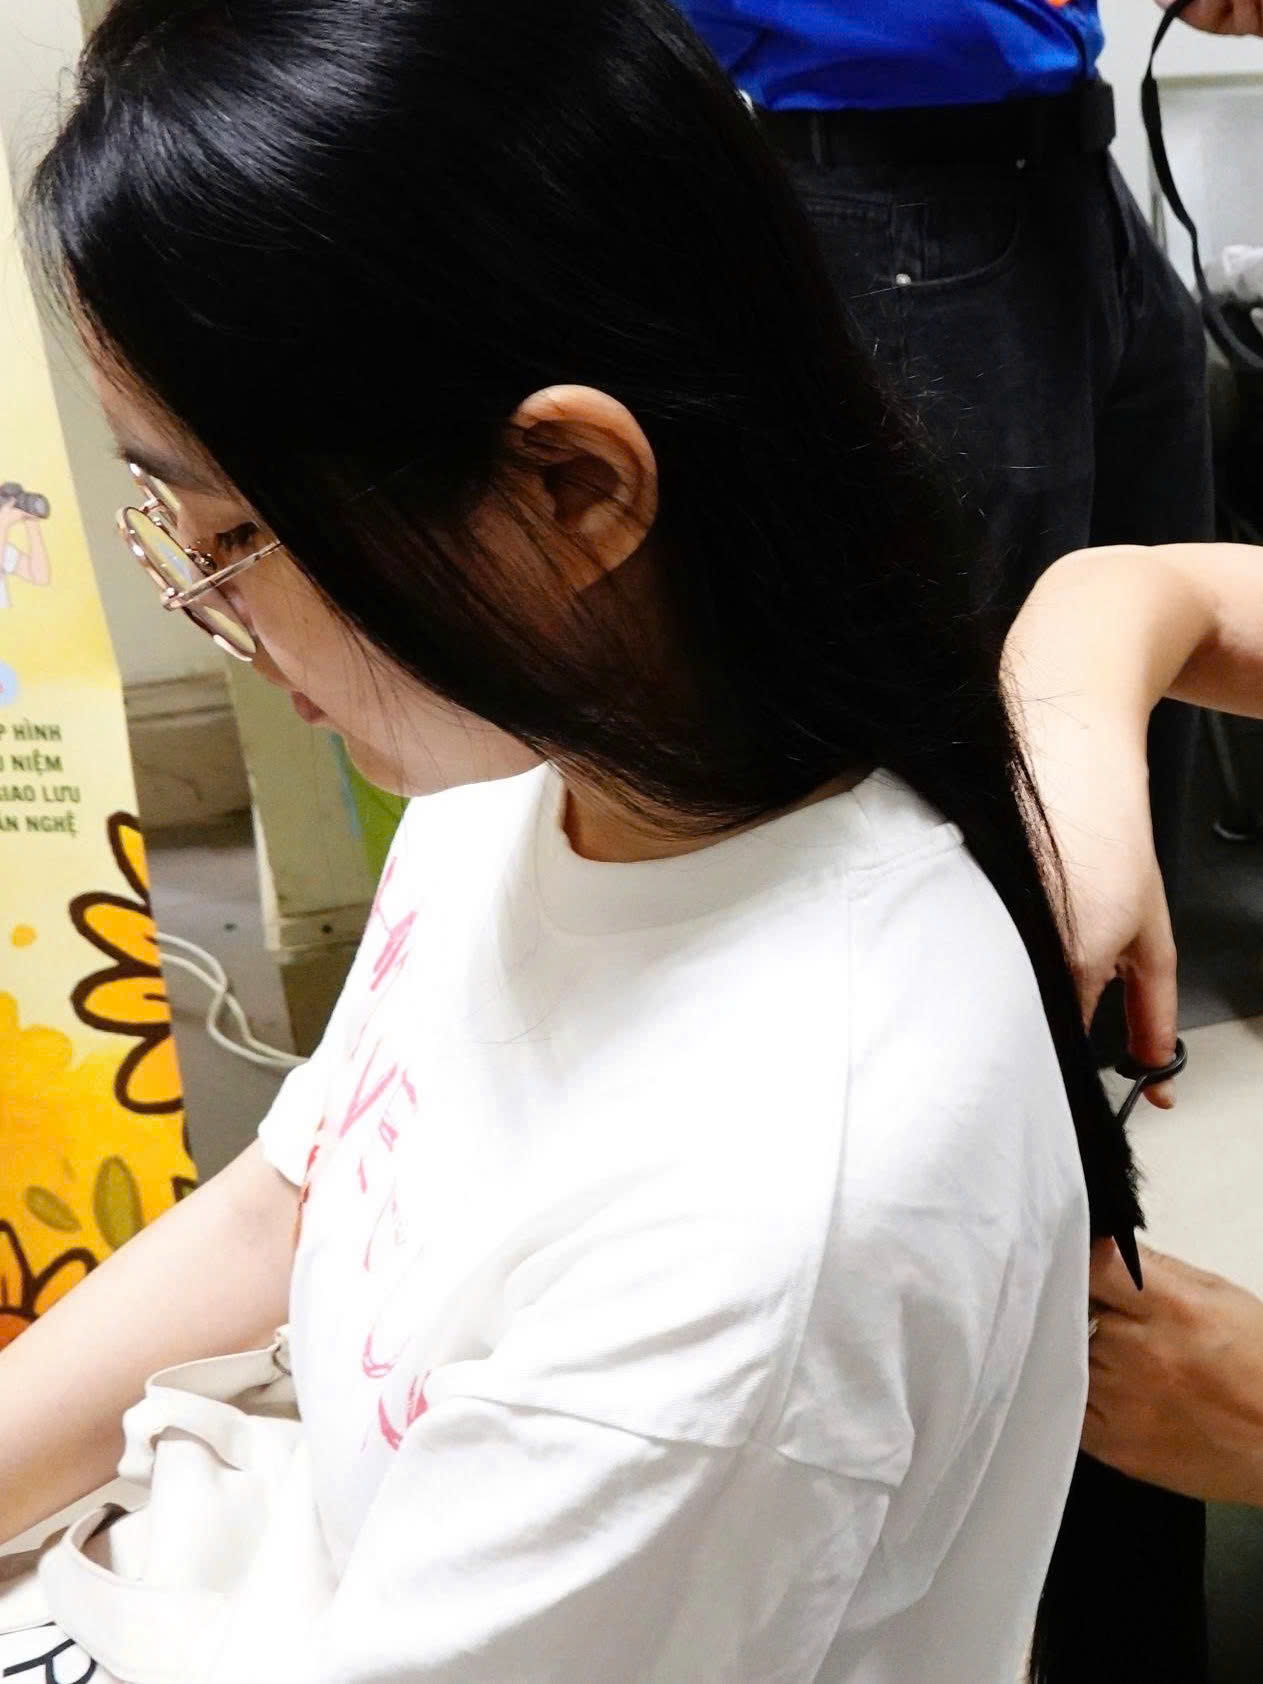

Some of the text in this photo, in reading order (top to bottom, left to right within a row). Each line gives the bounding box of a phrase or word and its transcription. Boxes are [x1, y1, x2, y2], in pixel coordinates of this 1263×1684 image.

[13, 717, 62, 741] HÌNH
[11, 748, 63, 776] NIỆM
[42, 785, 81, 803] LƯU
[25, 810, 77, 838] NGHỆ
